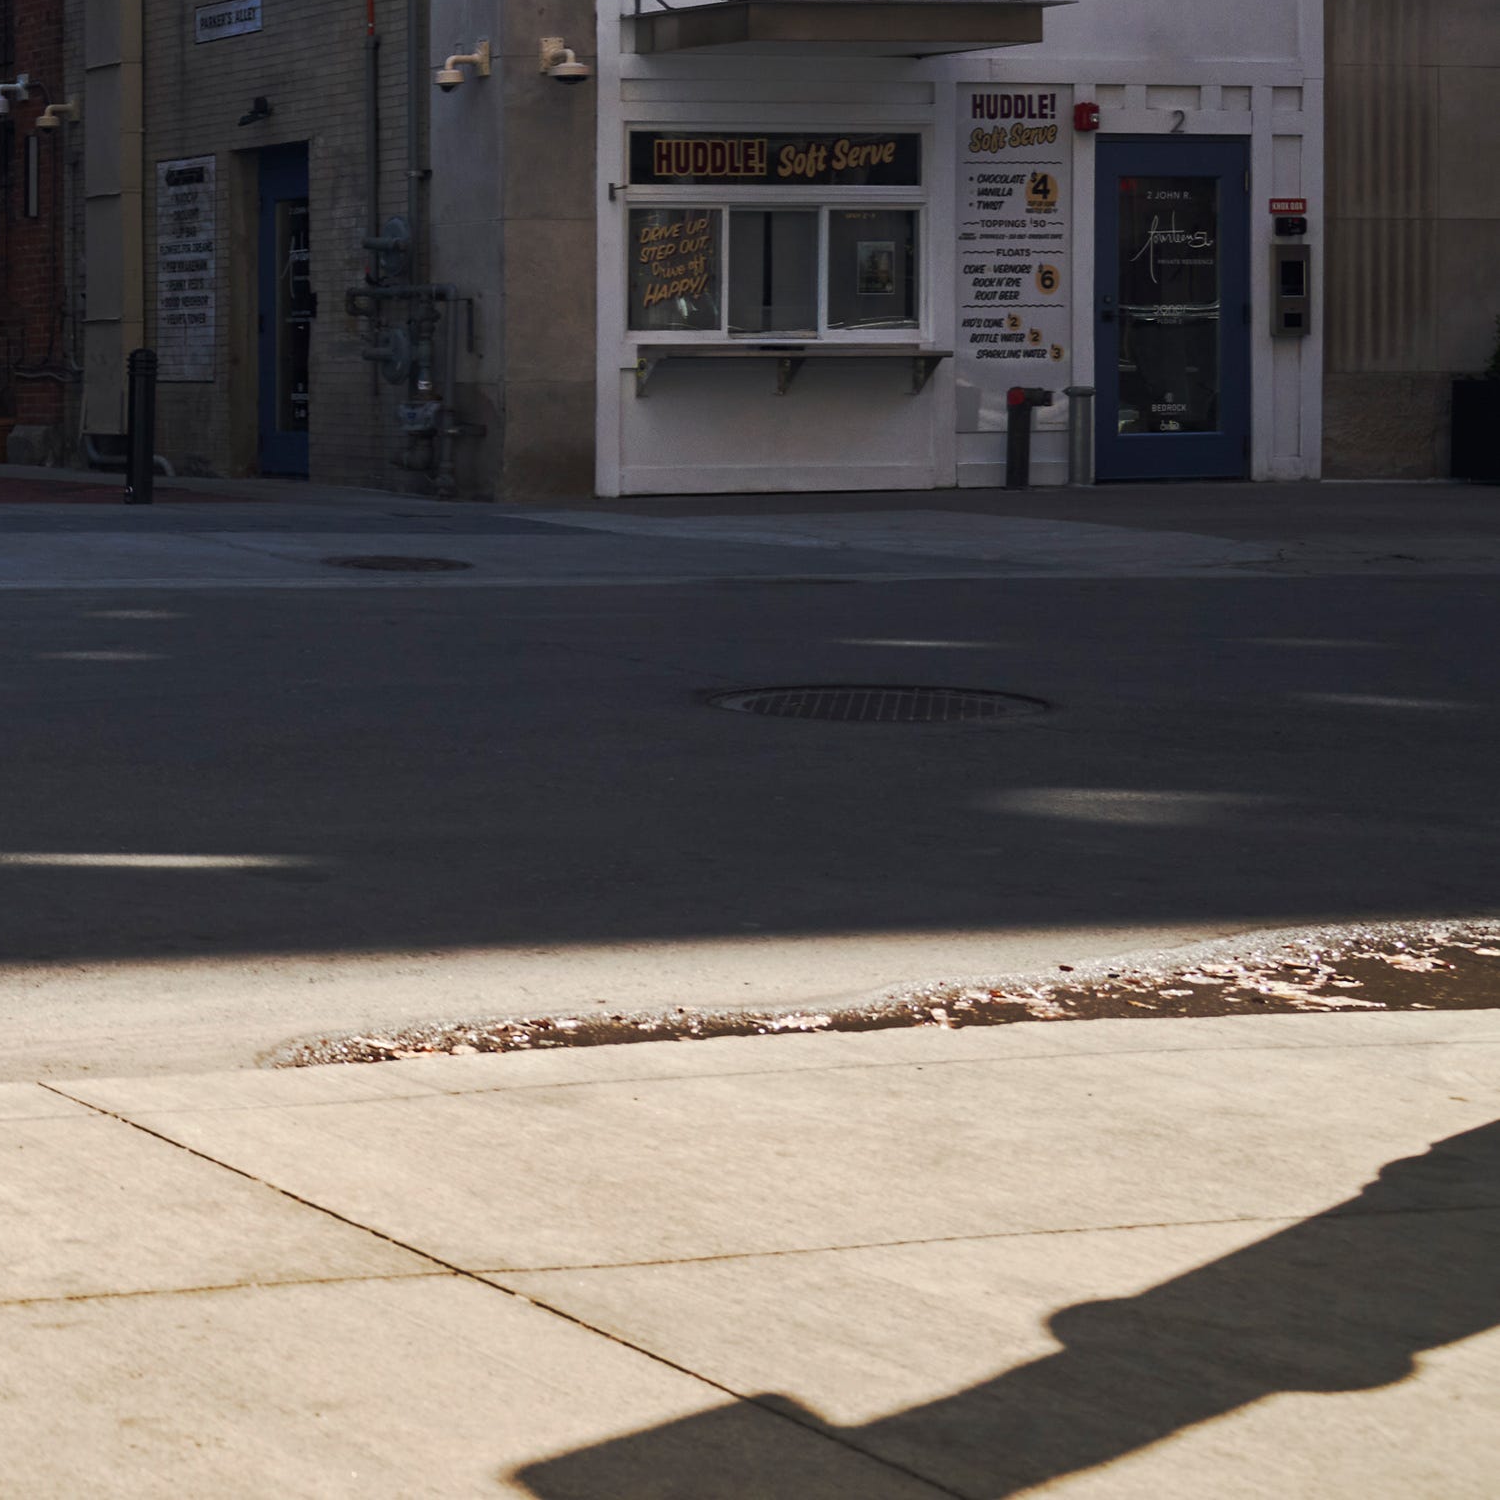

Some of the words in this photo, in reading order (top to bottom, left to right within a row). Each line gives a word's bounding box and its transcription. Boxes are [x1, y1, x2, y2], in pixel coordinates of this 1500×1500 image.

[200, 11, 232, 29] PARKER'S
[235, 7, 256, 23] ALLEY
[971, 92, 1056, 119] HUDDLE!
[1170, 110, 1186, 133] 2
[968, 125, 1008, 154] Soft
[1008, 122, 1058, 148] Serve
[653, 138, 768, 176] HUDDLE!
[776, 143, 827, 178] Soft
[831, 138, 896, 171] Serve
[977, 173, 1026, 185] CHOCOLATE
[1030, 169, 1050, 199] $4
[977, 187, 1013, 197] VANILLA
[1146, 191, 1153, 199] 2
[1154, 191, 1180, 200] JOHN
[977, 200, 1004, 210] TWIST
[980, 219, 1026, 228] TOPPINGS
[640, 223, 684, 244] DRIVE
[640, 243, 676, 264] STEP
[996, 249, 1031, 257] FLOATS
[963, 264, 986, 274] COKE
[993, 264, 1032, 274] VERNORS
[972, 277, 996, 287] ROCK
[644, 274, 709, 308] HAPPY!
[974, 290, 997, 301] ROOT
[998, 290, 1020, 301] BEER
[983, 318, 1004, 328] CONE
[970, 333, 998, 343] BOTTLE
[1000, 333, 1026, 343] WATER
[976, 349, 1021, 359] SPARKLING
[1022, 349, 1047, 359] WATER
[1152, 404, 1187, 412] BEDROCK
